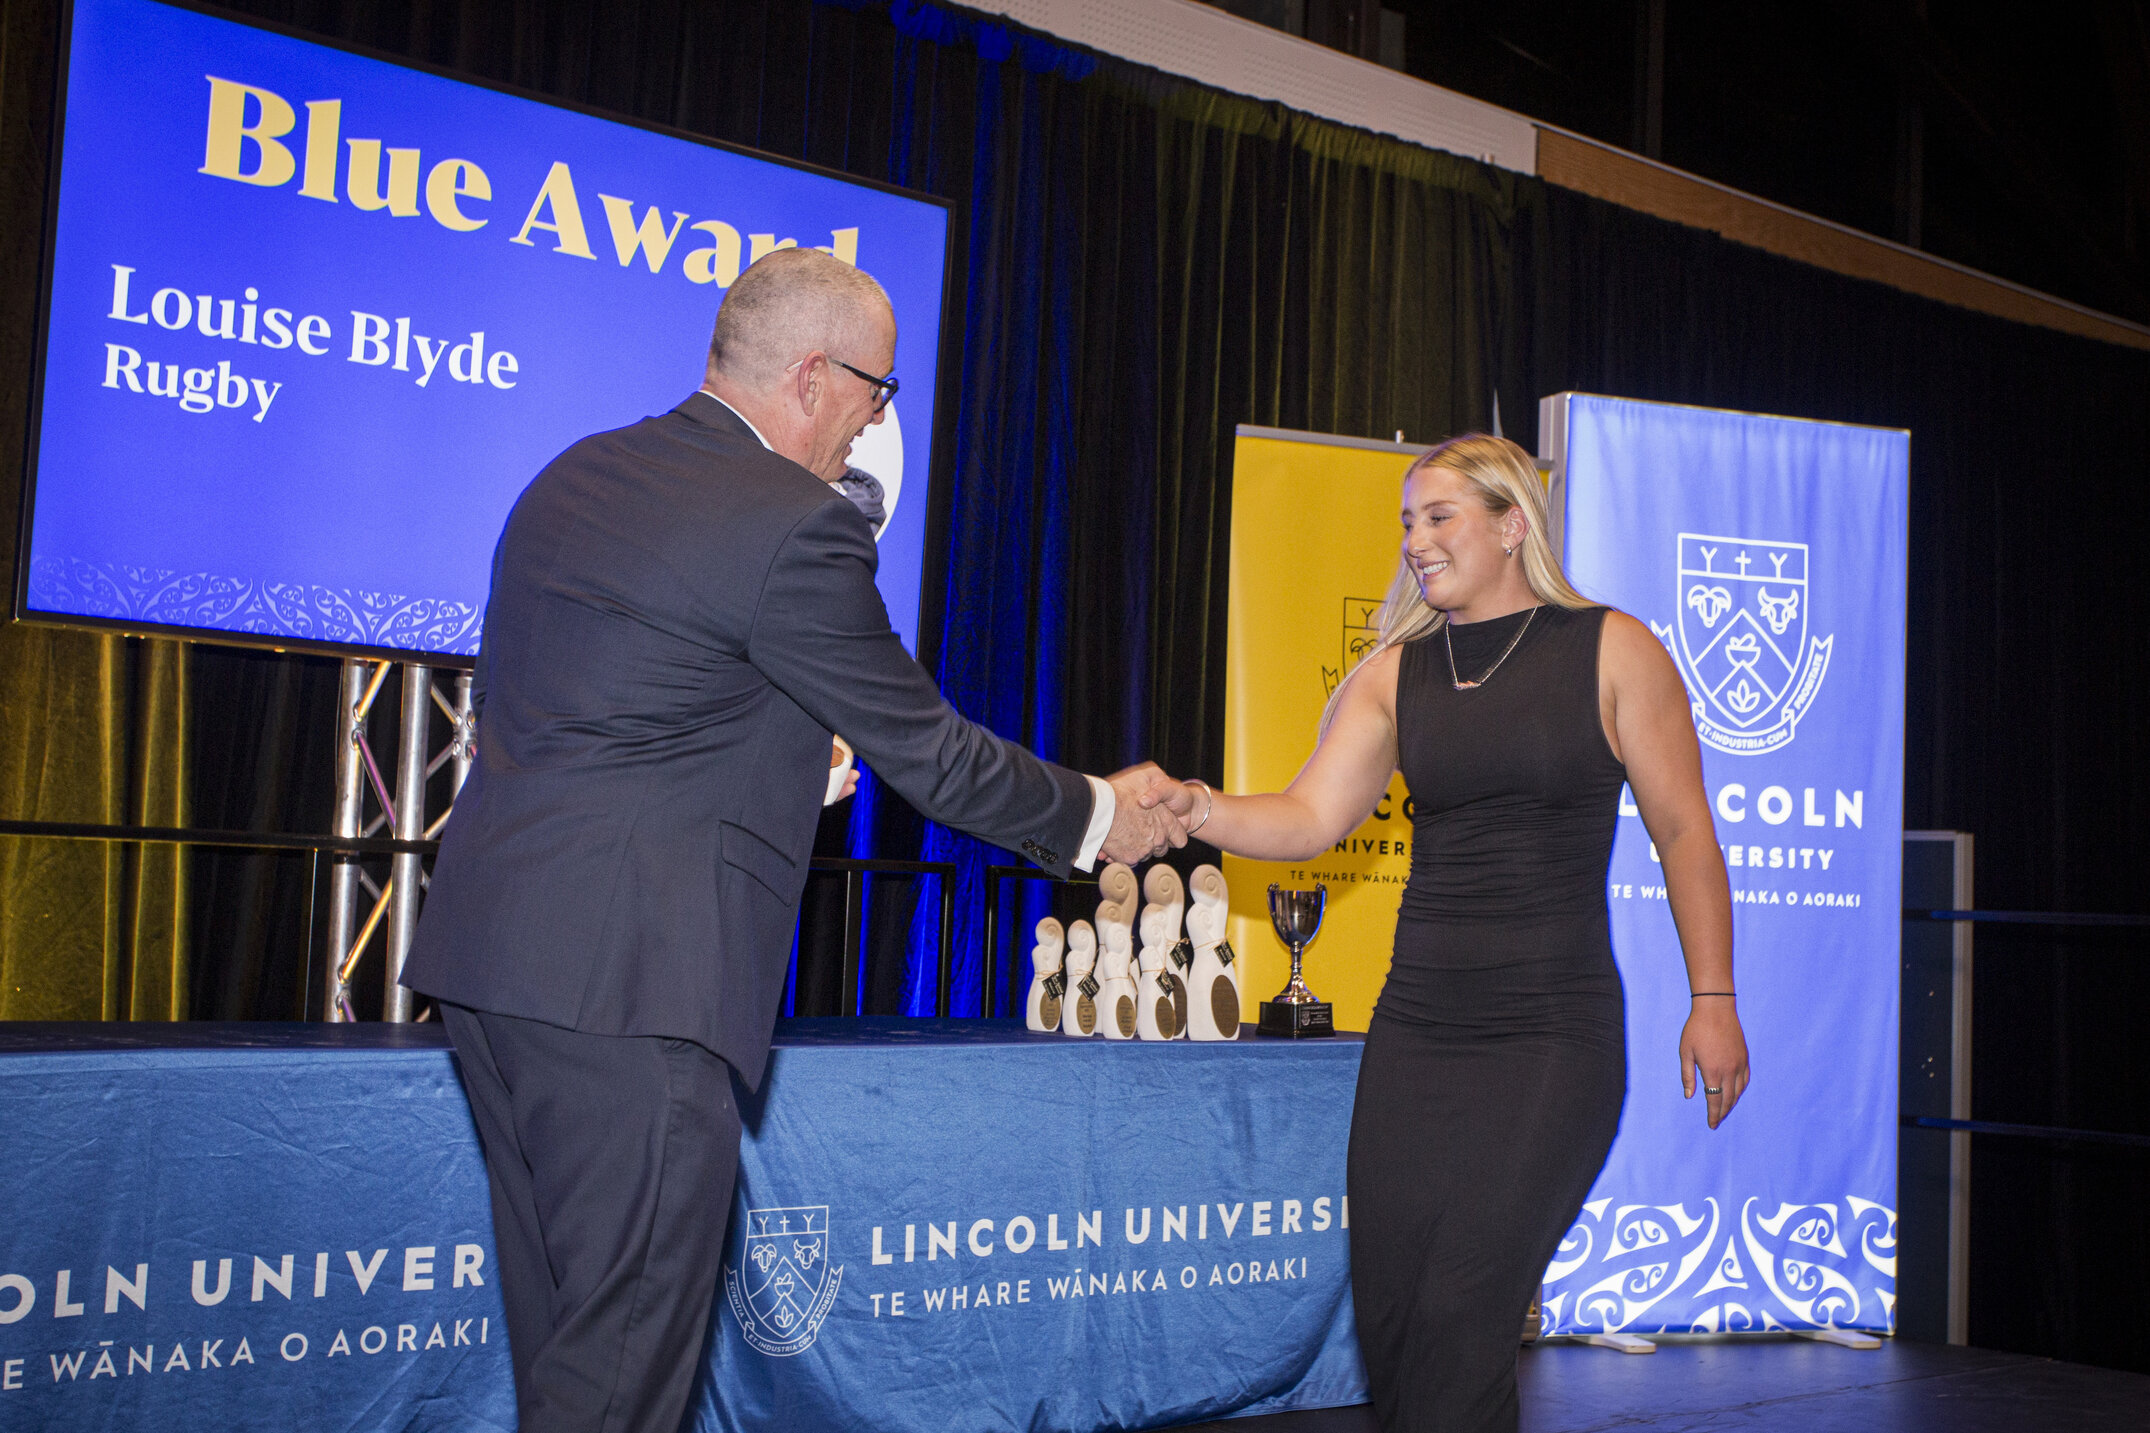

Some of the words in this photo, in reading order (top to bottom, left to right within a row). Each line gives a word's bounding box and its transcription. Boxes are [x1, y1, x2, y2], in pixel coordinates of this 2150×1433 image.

[198, 75, 492, 232] Blue
[107, 264, 331, 355] Louise
[347, 310, 519, 389] Blyde
[102, 342, 282, 423] Rugby
[1618, 783, 1863, 829] LCOLN
[1335, 839, 1405, 855] NIVER
[1650, 842, 1834, 870] UERSITY
[1290, 870, 1304, 880] TE
[1311, 872, 1357, 882] WHARE
[1362, 872, 1408, 884] WĀNAK
[1611, 884, 1633, 899] TE
[1734, 889, 1780, 905] NAKA
[1786, 891, 1798, 906] O
[1803, 893, 1861, 908] AORAKI
[872, 1210, 1102, 1266] LINCOLN
[1125, 1196, 1349, 1244] UNIVERSI
[191, 1243, 485, 1307] UNIVER
[729, 1281, 745, 1318] SCIENTIA
[816, 1279, 838, 1320] PROBITATE
[870, 1292, 905, 1318] TE
[923, 1279, 1031, 1313] WHARE
[1047, 1268, 1168, 1300] WĀNAKA
[1180, 1266, 1197, 1289] O
[1208, 1257, 1307, 1286] AORAKI
[50, 1336, 255, 1384] WĀNAKA
[280, 1332, 308, 1362] O
[327, 1317, 488, 1357] AORAKI
